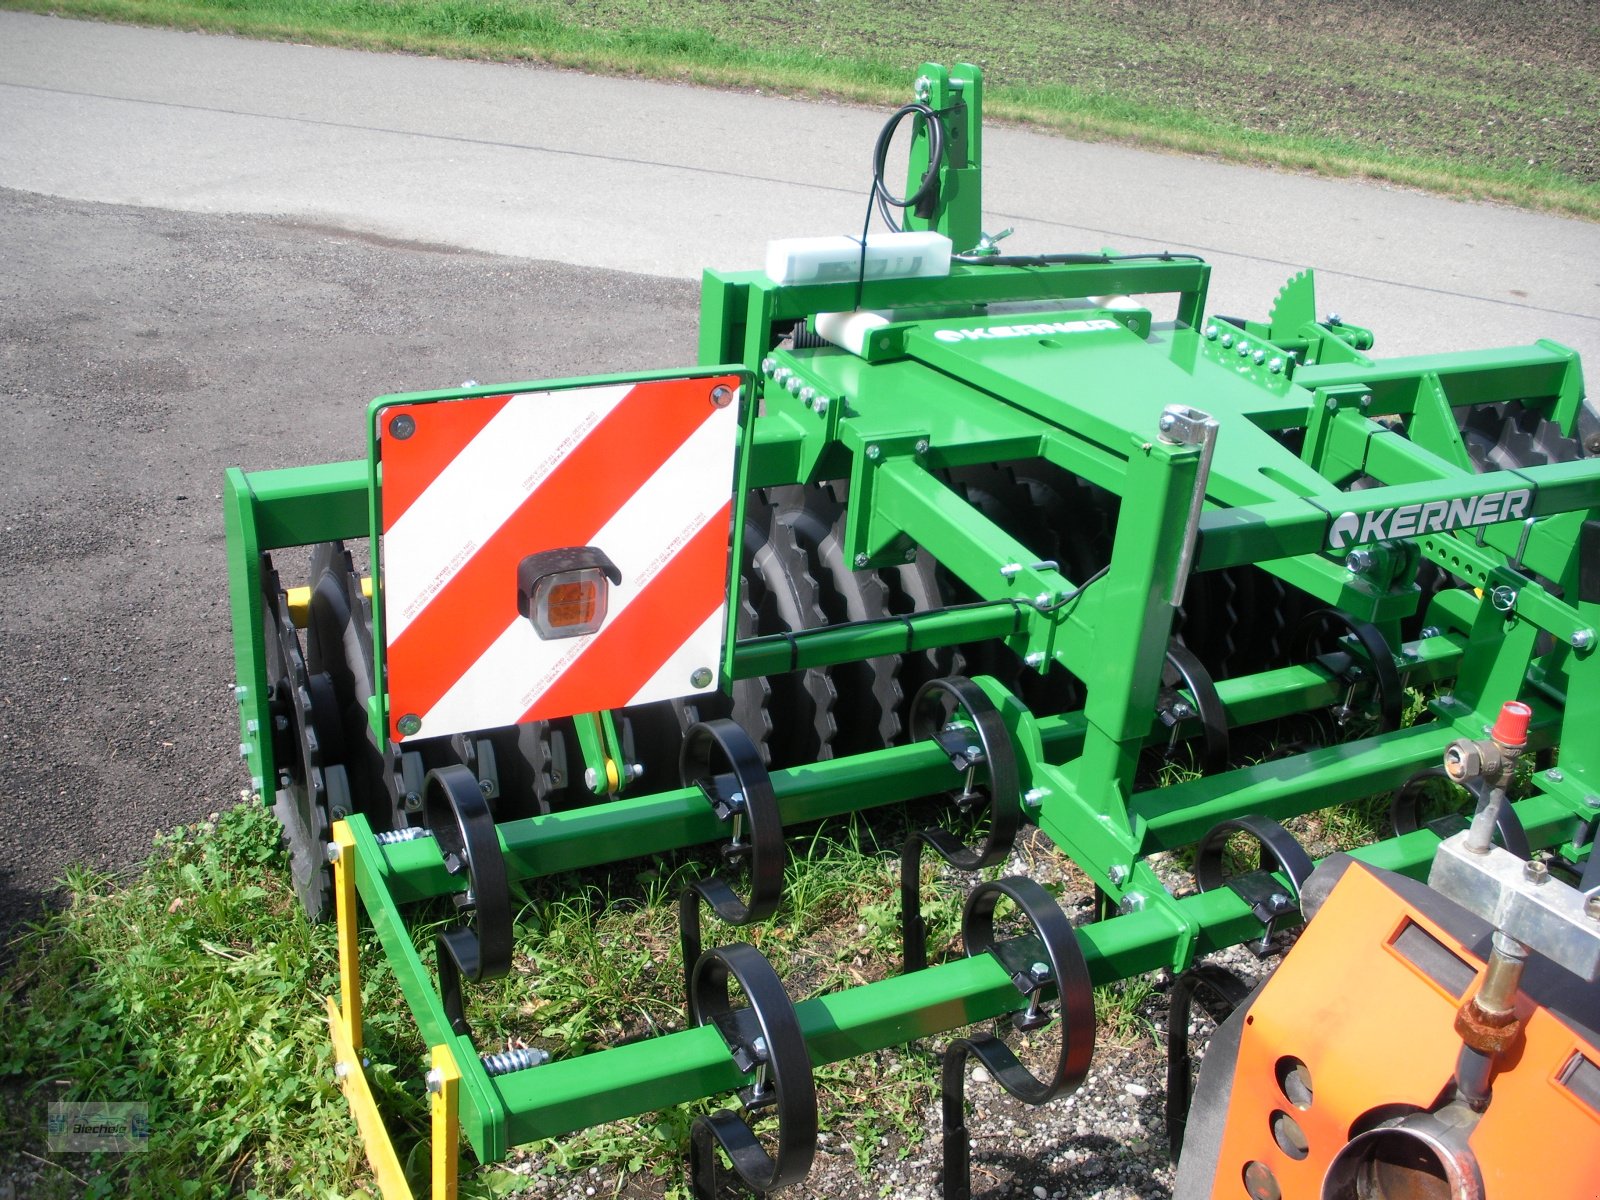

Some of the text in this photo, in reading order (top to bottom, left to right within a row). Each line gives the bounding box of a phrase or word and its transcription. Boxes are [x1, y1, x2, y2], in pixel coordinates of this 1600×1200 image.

[960, 319, 1121, 340] KERNER
[556, 437, 571, 452] GEKA
[550, 450, 564, 465] GEKA
[1359, 488, 1531, 543] KERNER
[667, 536, 680, 550] GEKA
[660, 548, 674, 562] GEKA
[435, 566, 450, 581] GEKA
[430, 578, 444, 593] GEKA
